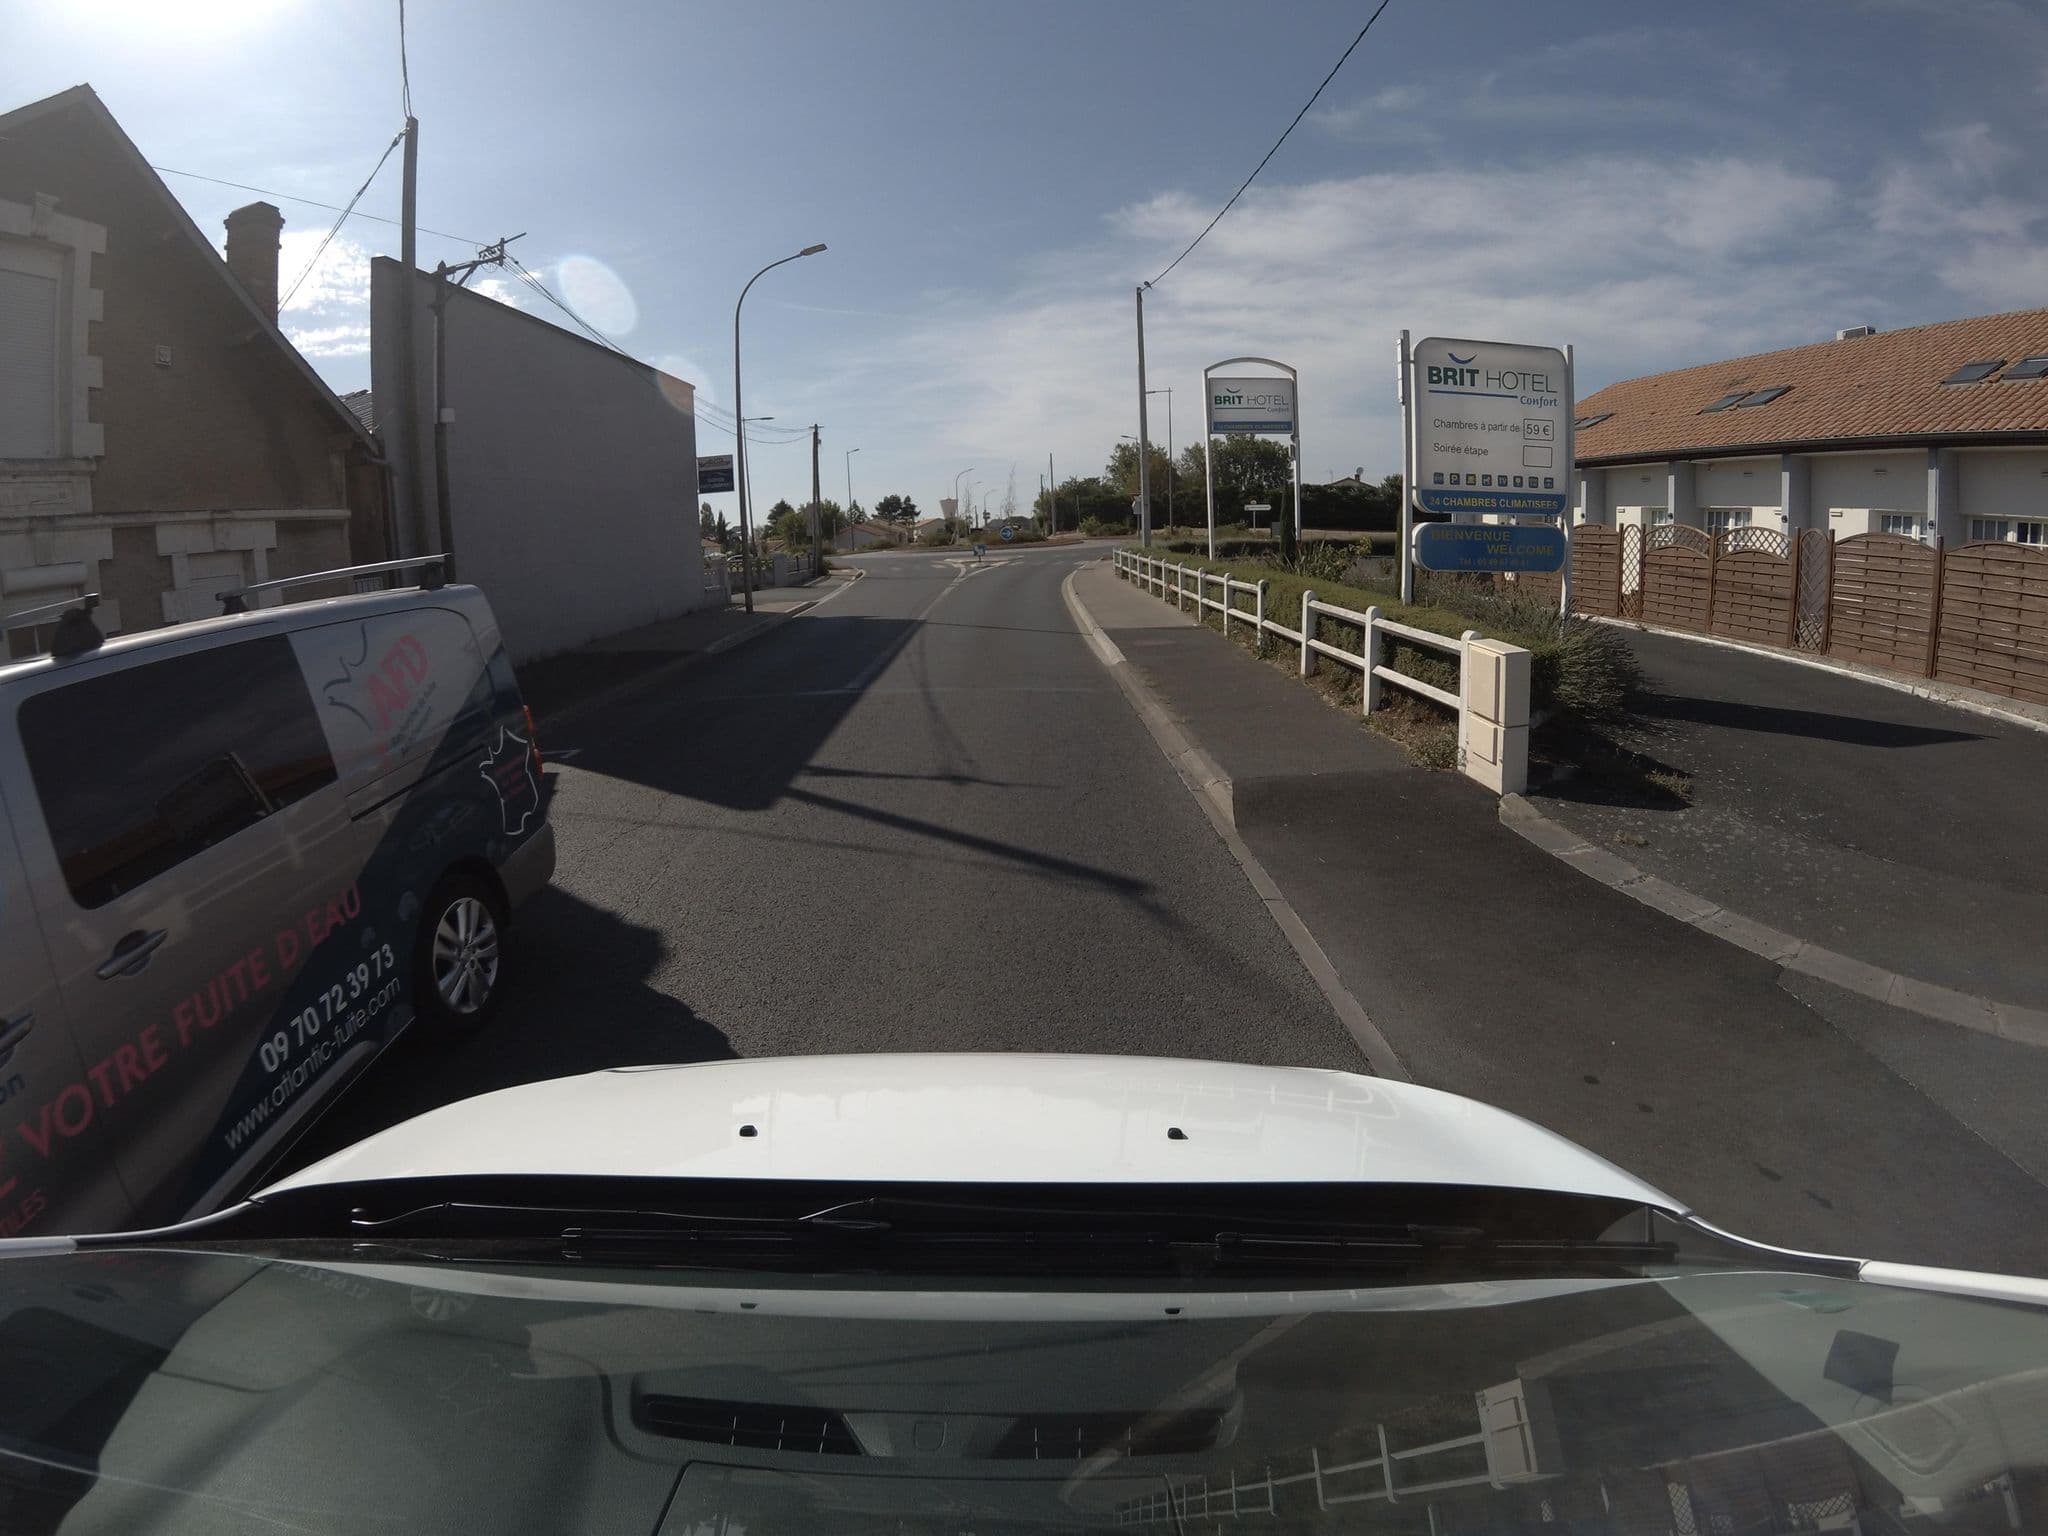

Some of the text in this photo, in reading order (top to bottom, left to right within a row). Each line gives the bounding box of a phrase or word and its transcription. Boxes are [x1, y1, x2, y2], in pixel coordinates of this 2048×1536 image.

[1428, 366, 1558, 393] BRIT HOTEL
[1214, 395, 1289, 405] BRIT HOTEL
[1520, 395, 1559, 408] Confort
[1433, 418, 1521, 433] Chambres à partir de
[1526, 424, 1550, 436] 59 €
[1433, 443, 1489, 456] Soirée étape
[1442, 497, 1497, 507] CHAMBRES
[1500, 498, 1559, 509] CLIMATISEES
[1431, 529, 1512, 541] BIENVENUE
[1487, 544, 1553, 555] WELCOME
[259, 943, 394, 1073] 09 70 72 39 73
[17, 1023, 168, 1160] VOTRE
[172, 945, 272, 1048] FUITE
[224, 976, 401, 1151] www.atlantic-fuite.com
